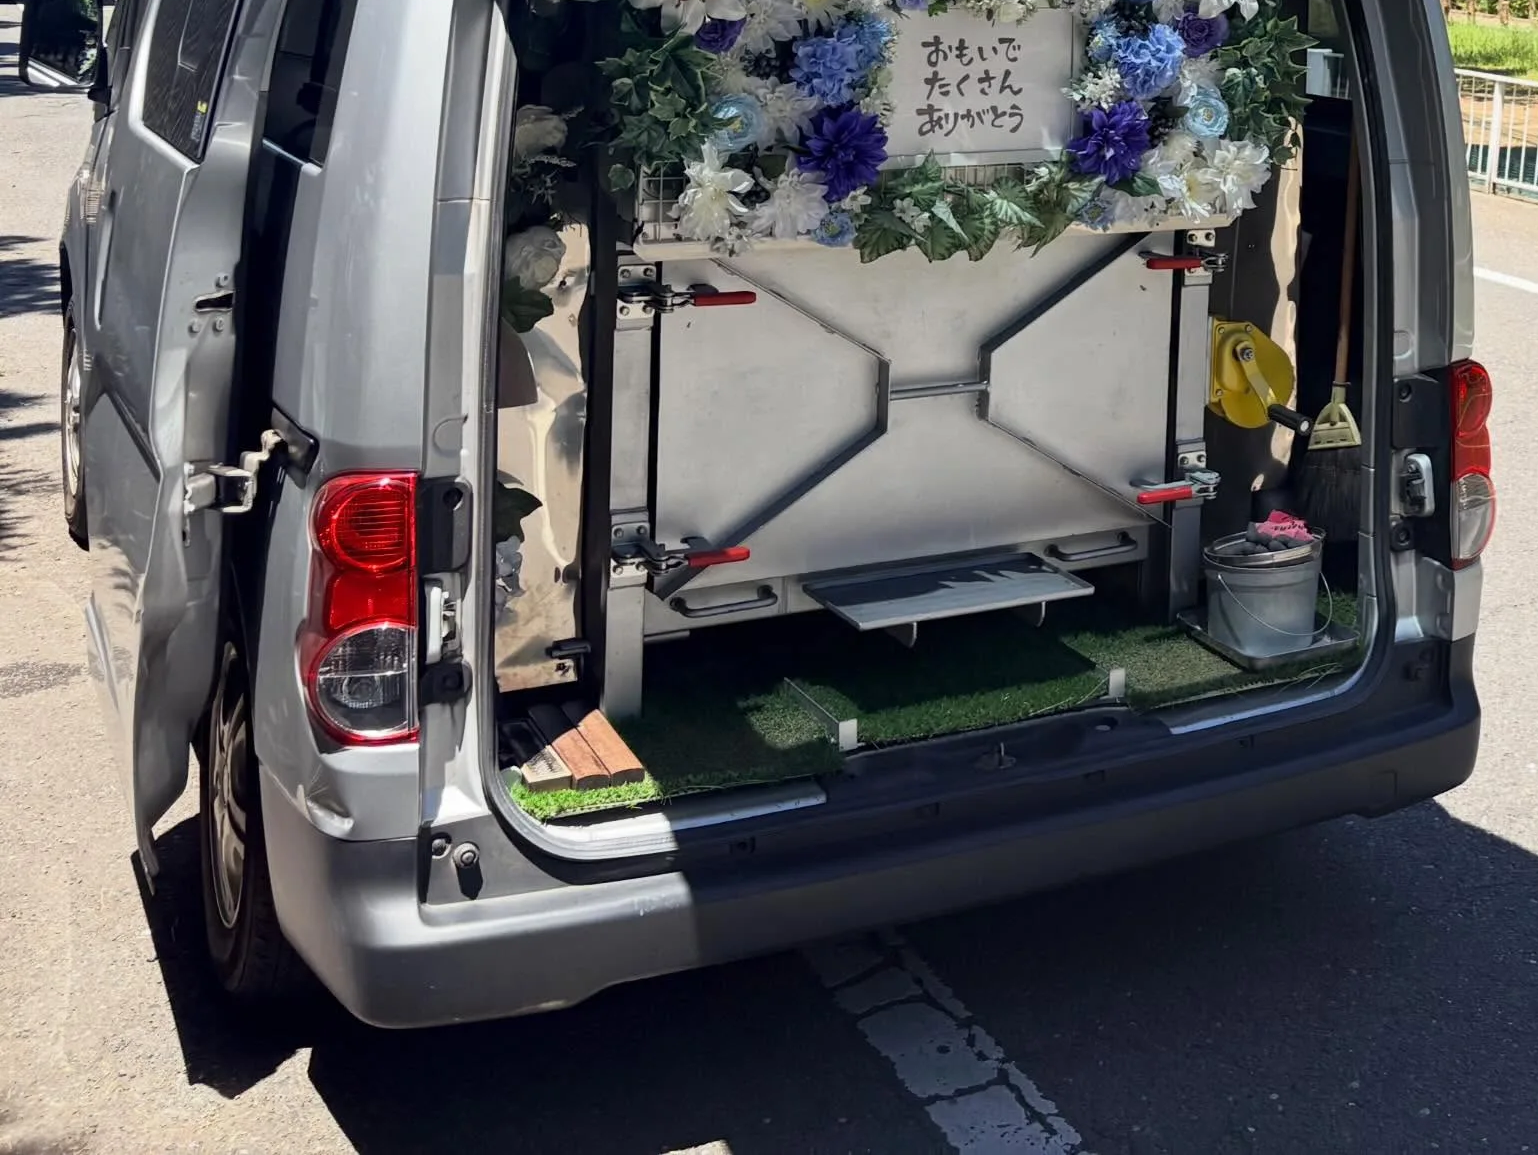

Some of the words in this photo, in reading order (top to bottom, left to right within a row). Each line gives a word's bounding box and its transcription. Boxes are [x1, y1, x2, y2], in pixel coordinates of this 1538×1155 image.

[921, 35, 1021, 67] おもいで
[924, 69, 1023, 100] たくさん
[916, 104, 1024, 137] ありがとう
